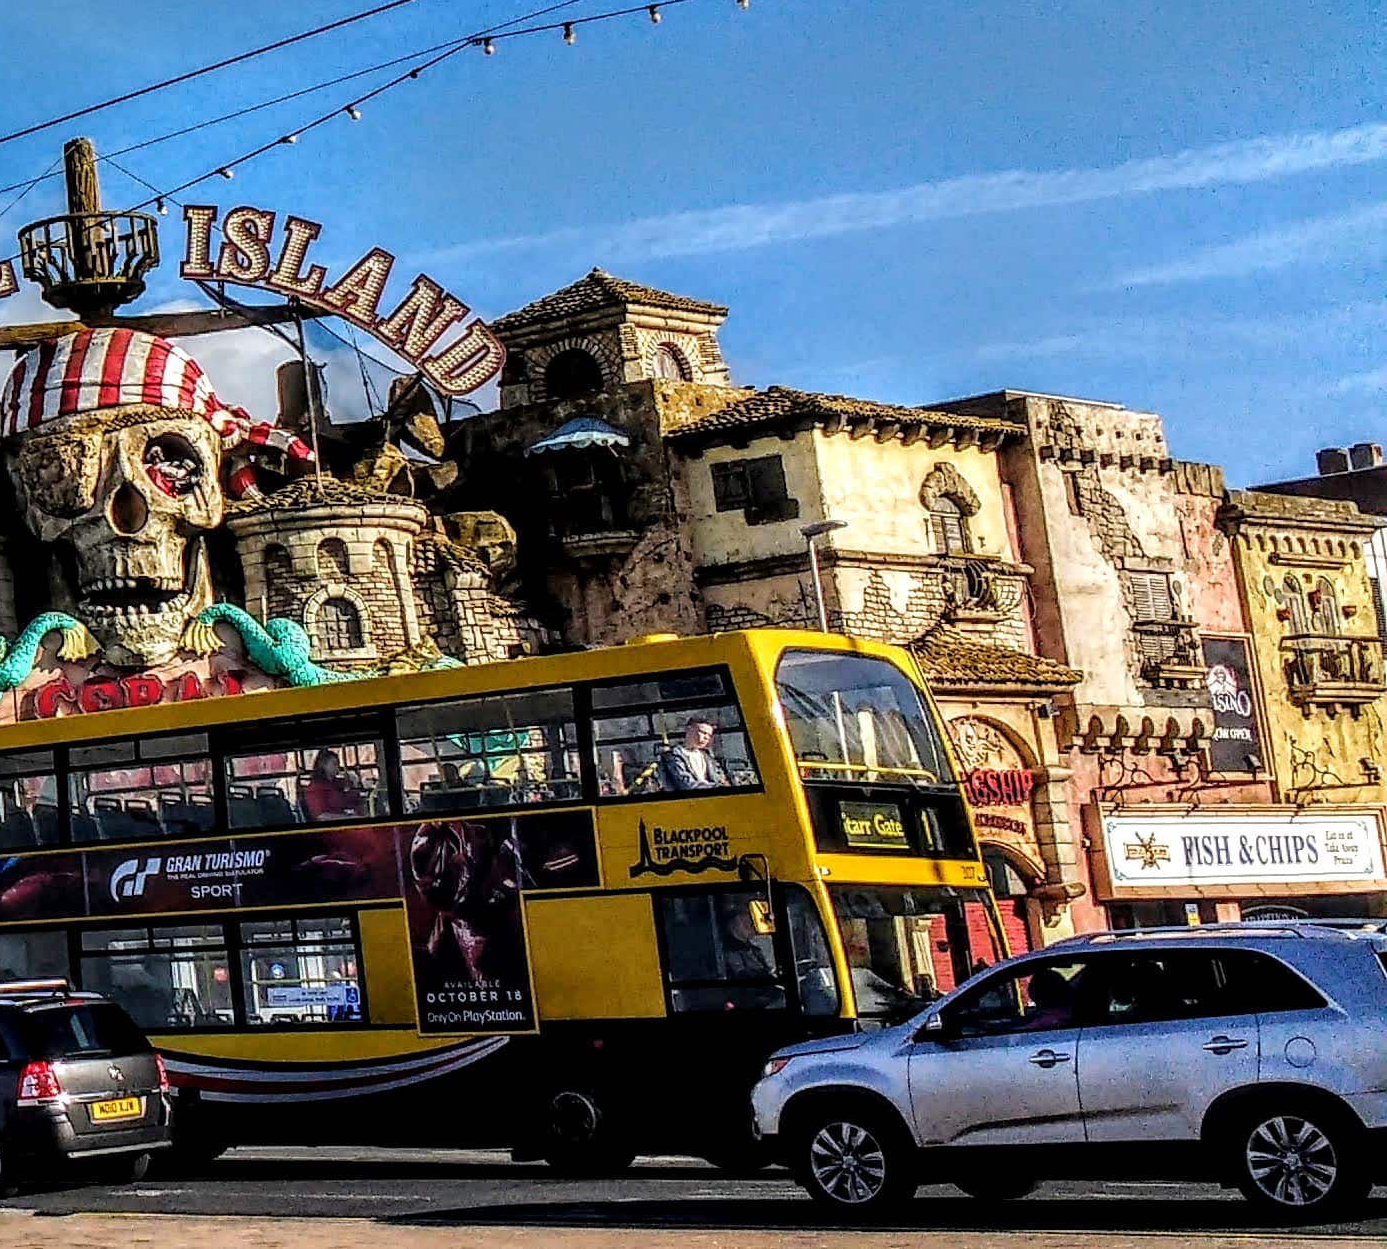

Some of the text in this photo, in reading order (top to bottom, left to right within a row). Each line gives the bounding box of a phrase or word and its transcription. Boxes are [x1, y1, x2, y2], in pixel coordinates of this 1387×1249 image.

[179, 204, 507, 397] ISLAND
[873, 813, 905, 838] Gate
[653, 826, 729, 845] BLACKPOOL
[655, 842, 729, 861] TRANSPORT
[1180, 835, 1233, 866] FISH
[1255, 834, 1319, 865] CHIPS
[165, 855, 202, 873] GRAN
[204, 850, 265, 870] TURISMO
[190, 883, 244, 899] SPORT
[444, 979, 501, 990] AVAILABLE
[426, 990, 523, 1003] OCTOBER 18
[427, 1011, 448, 1025] Only
[448, 1011, 462, 1023] On
